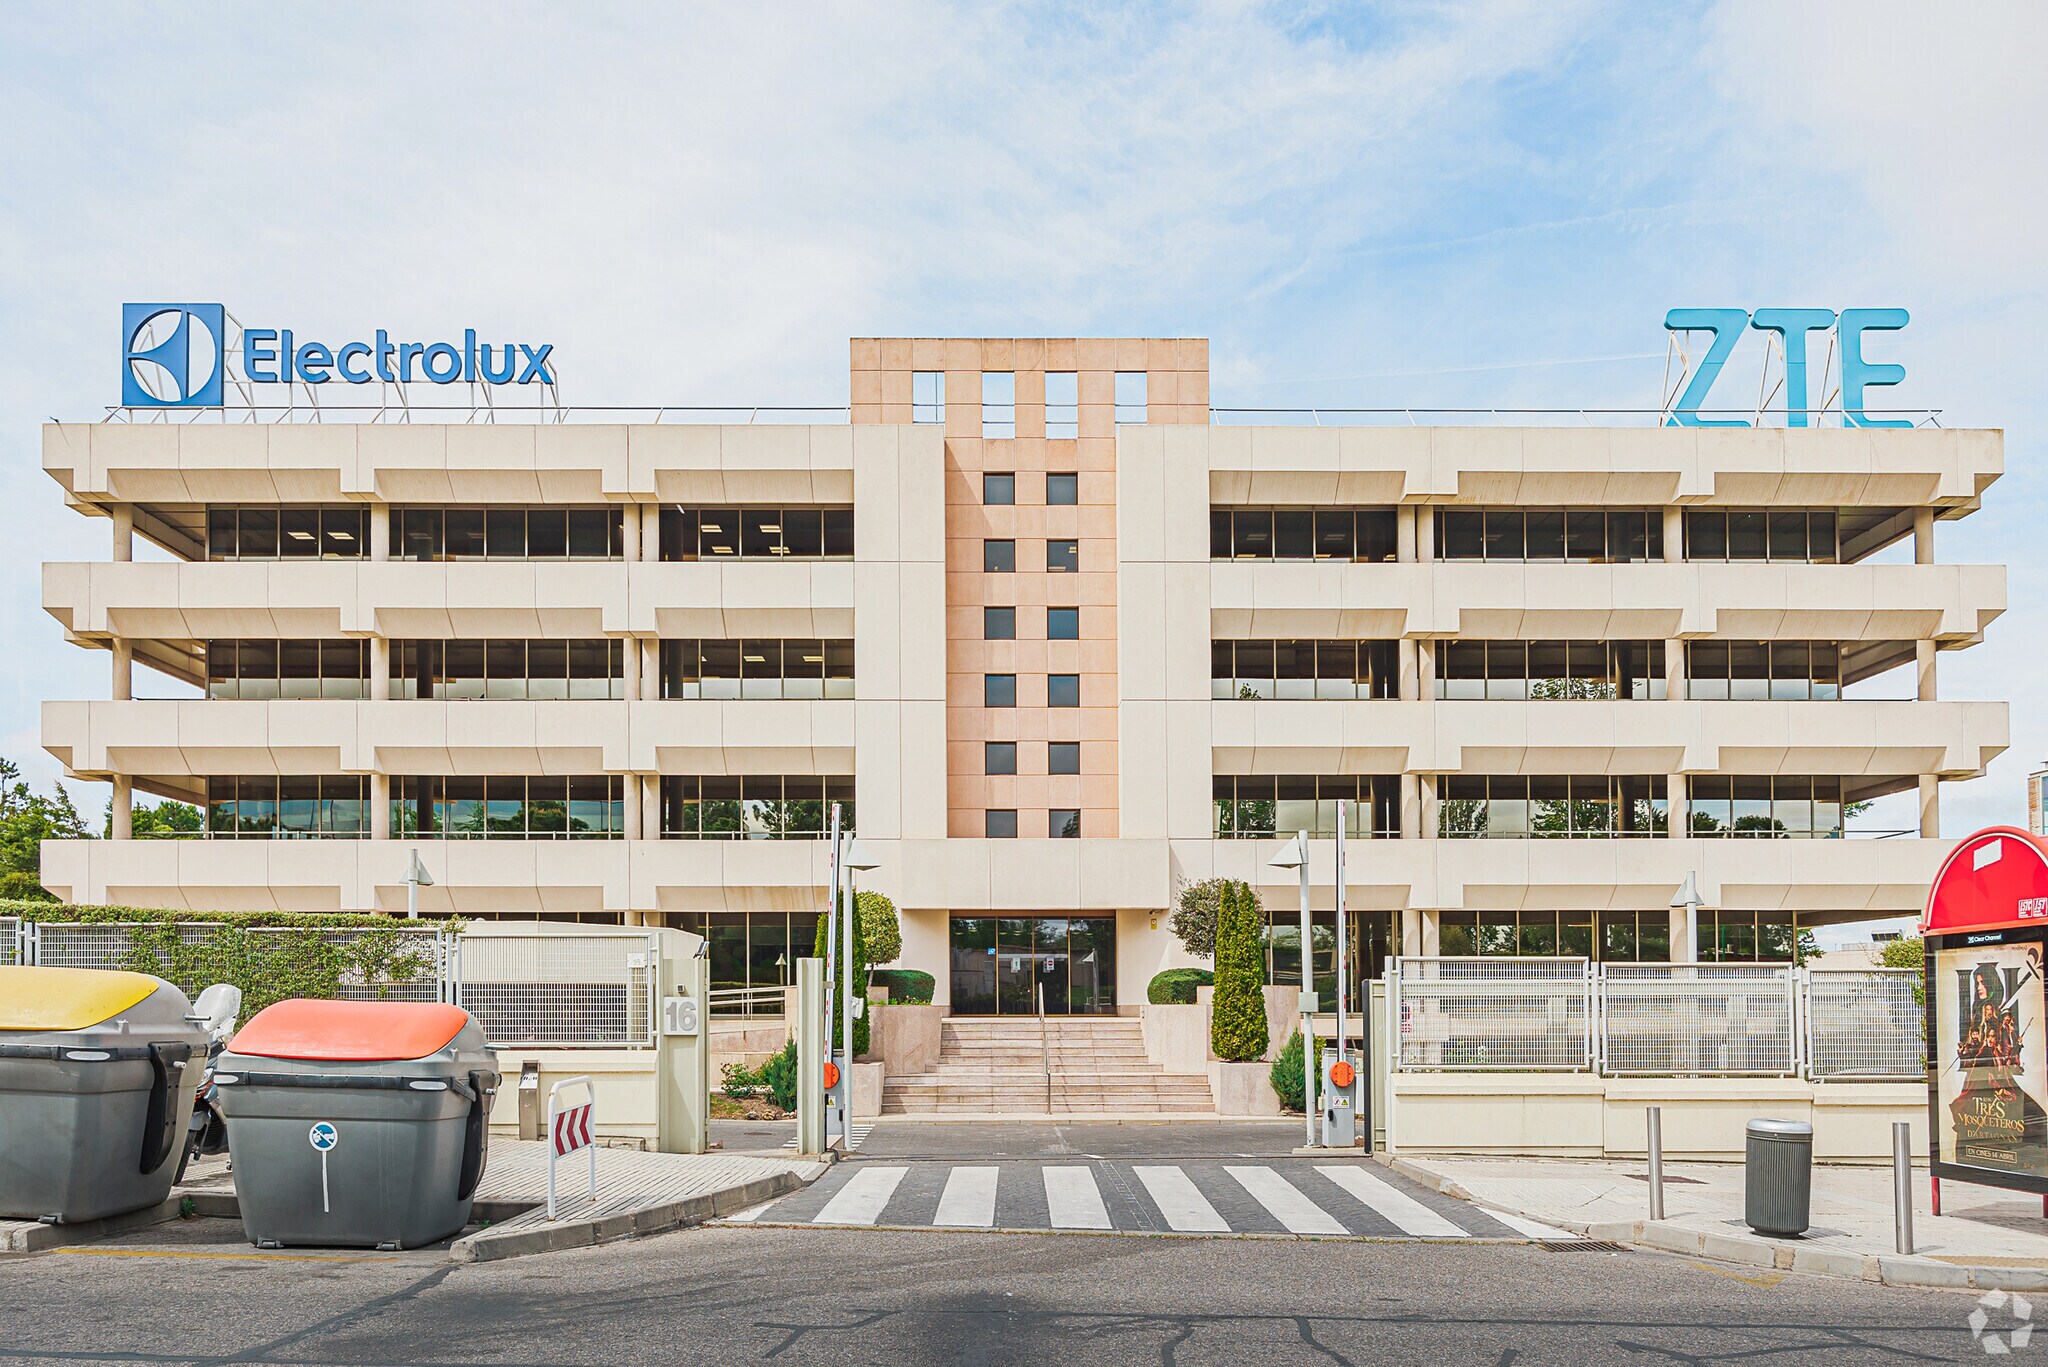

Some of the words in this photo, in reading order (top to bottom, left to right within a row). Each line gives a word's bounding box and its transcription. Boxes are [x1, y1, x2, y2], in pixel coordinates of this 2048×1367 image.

[244, 329, 553, 384] Electrolux
[1664, 308, 1915, 427] ZTE
[666, 1001, 697, 1031] 16
[1973, 1097, 2005, 1118] TRES
[1958, 1113, 2025, 1132] MOSQUETEROS
[1976, 1149, 1991, 1157] CINES
[1999, 1152, 2015, 1161] ABRIL
